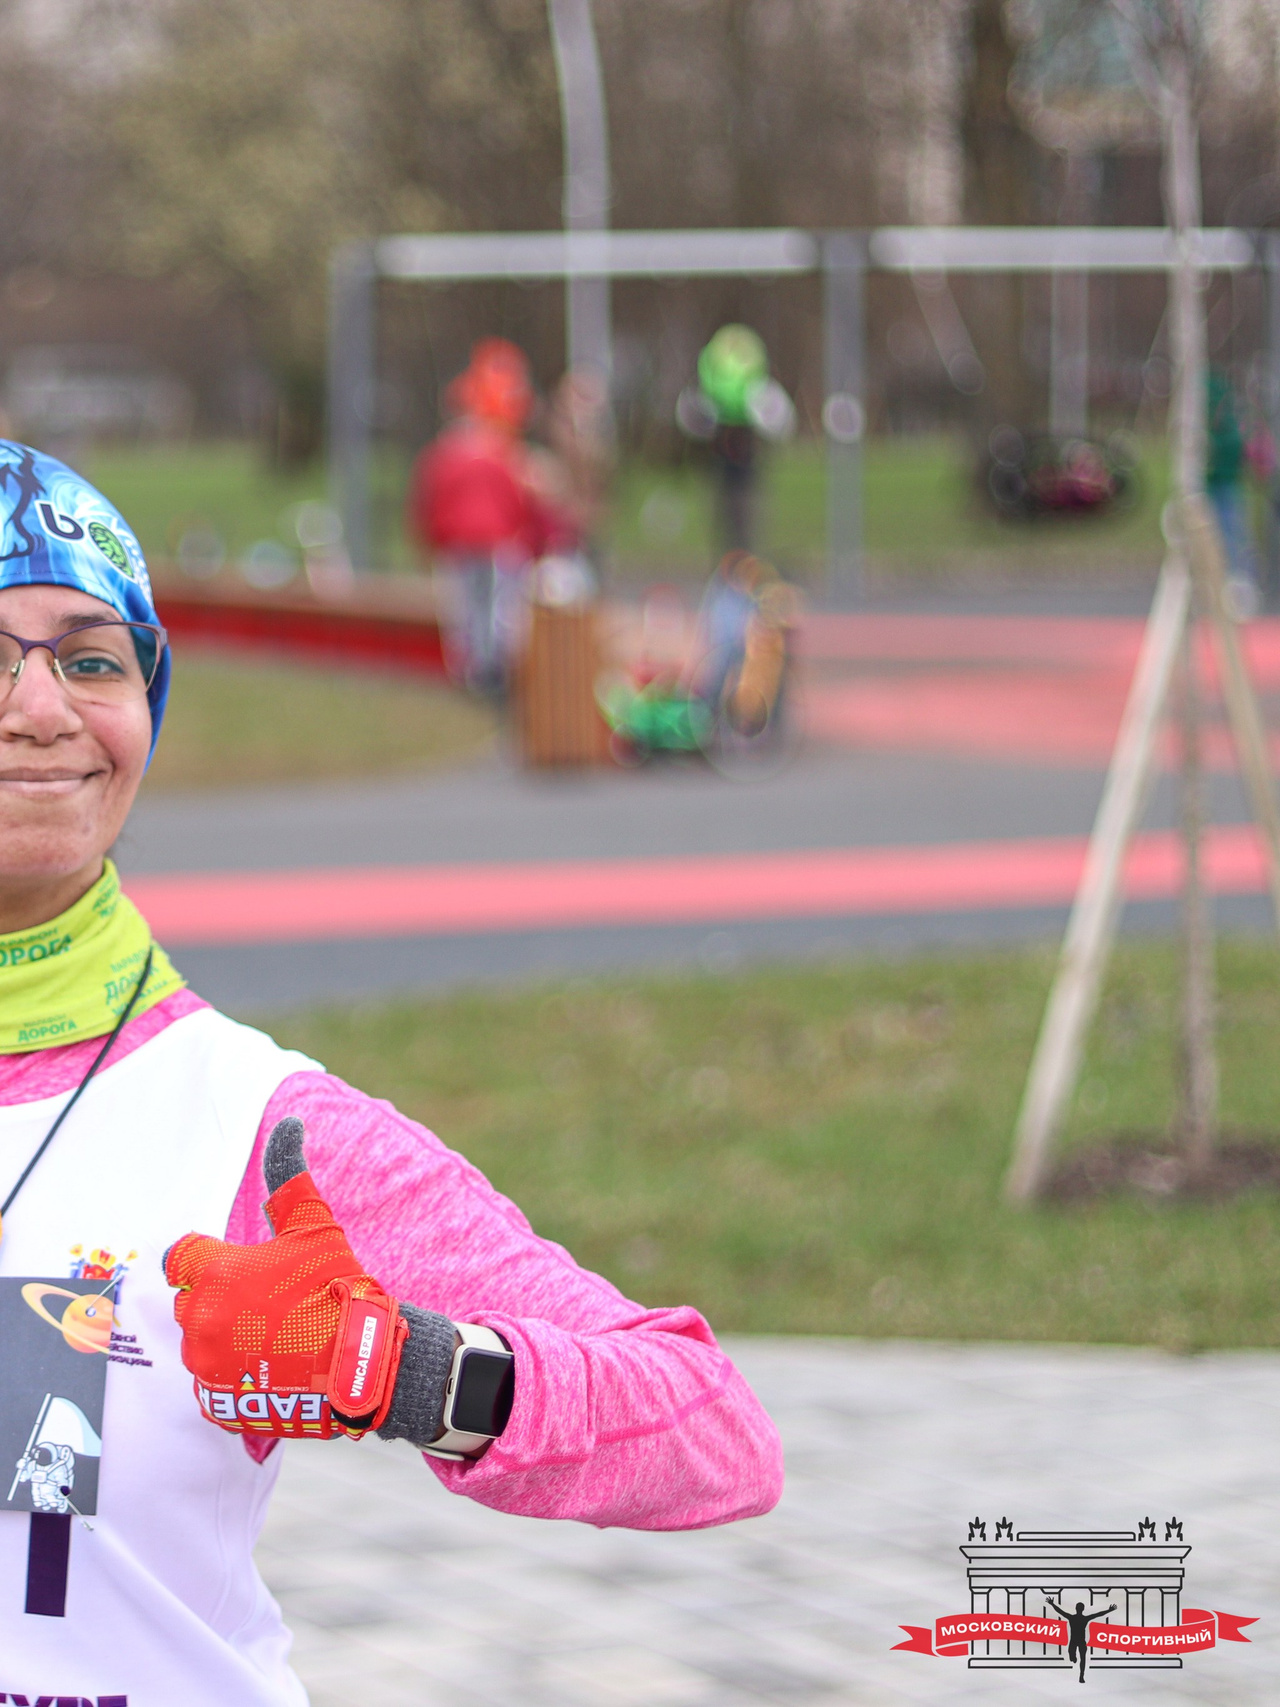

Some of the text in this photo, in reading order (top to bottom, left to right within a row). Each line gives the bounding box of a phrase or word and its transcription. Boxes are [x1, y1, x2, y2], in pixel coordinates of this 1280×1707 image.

[17, 1019, 78, 1043] ДОРОГА
[361, 1317, 376, 1357] SPORT
[259, 1359, 269, 1389] NEW
[350, 1360, 369, 1398] VINCA
[198, 1381, 338, 1421] EADER
